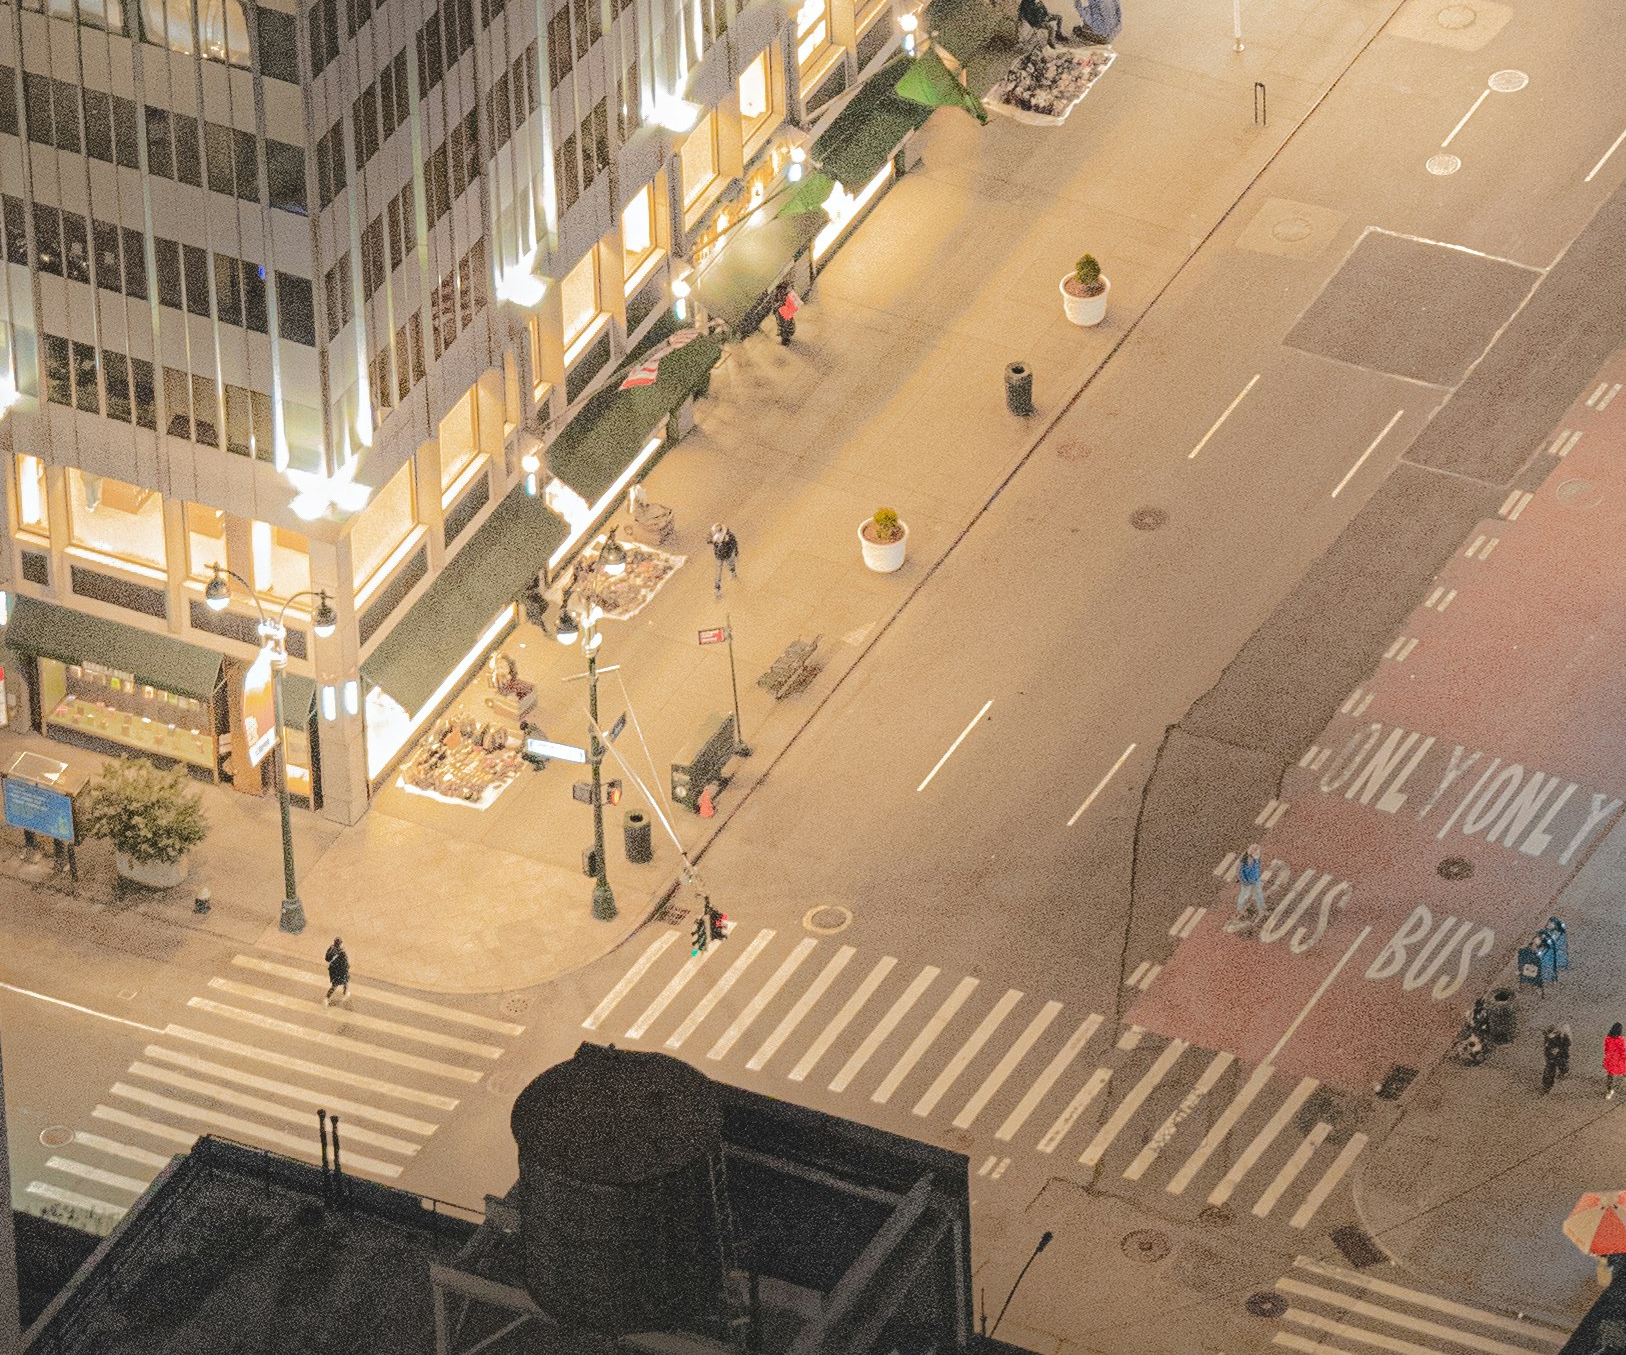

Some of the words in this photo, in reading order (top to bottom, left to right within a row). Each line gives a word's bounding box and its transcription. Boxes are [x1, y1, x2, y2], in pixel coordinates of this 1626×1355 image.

[1320, 723, 1481, 820] ONLY
[1463, 763, 1622, 865] ONLY
[1364, 903, 1496, 1001] BUS
